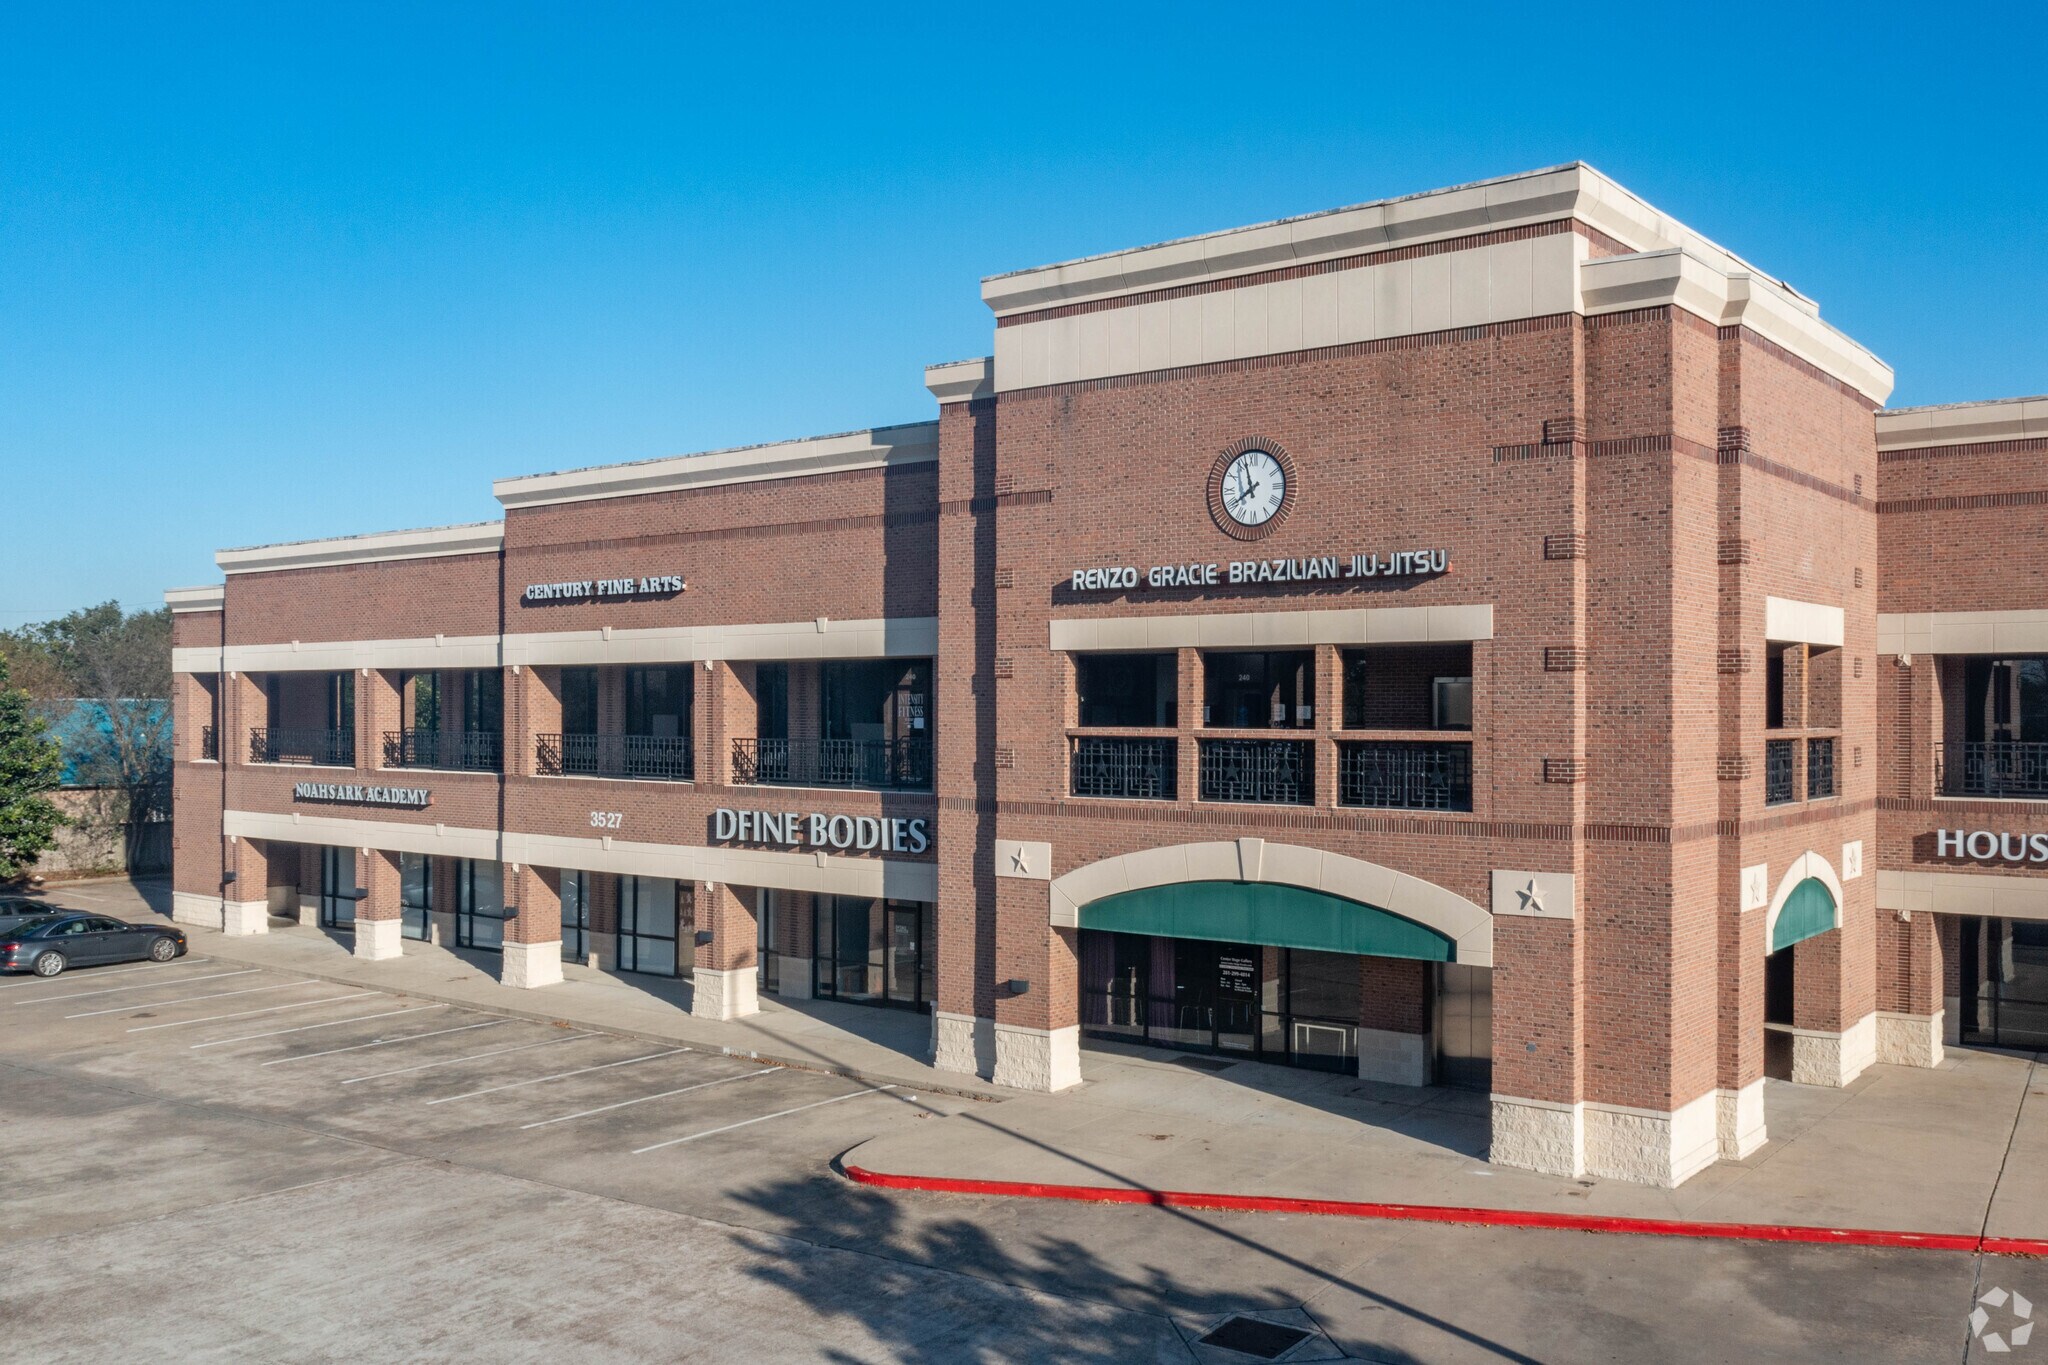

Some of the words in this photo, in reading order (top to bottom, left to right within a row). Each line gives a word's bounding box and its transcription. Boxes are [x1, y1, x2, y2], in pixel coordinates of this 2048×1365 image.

[1072, 567, 1138, 591] RENZO
[1149, 563, 1219, 587] GRACIE
[1229, 556, 1338, 583] BRAZILIAN
[1345, 549, 1447, 577] JIU-JITSU
[526, 581, 592, 600] CENTURY
[598, 578, 634, 596] FINE
[639, 575, 682, 594] ARTS
[898, 693, 924, 705] INTENSITY
[898, 705, 924, 717] FITNESS
[337, 784, 364, 801] ARK
[366, 786, 428, 805] ACADEMY
[589, 811, 623, 829] 3527
[716, 808, 799, 845] DFINE
[810, 812, 927, 854] BODIES
[1937, 828, 2048, 863] HOUS
